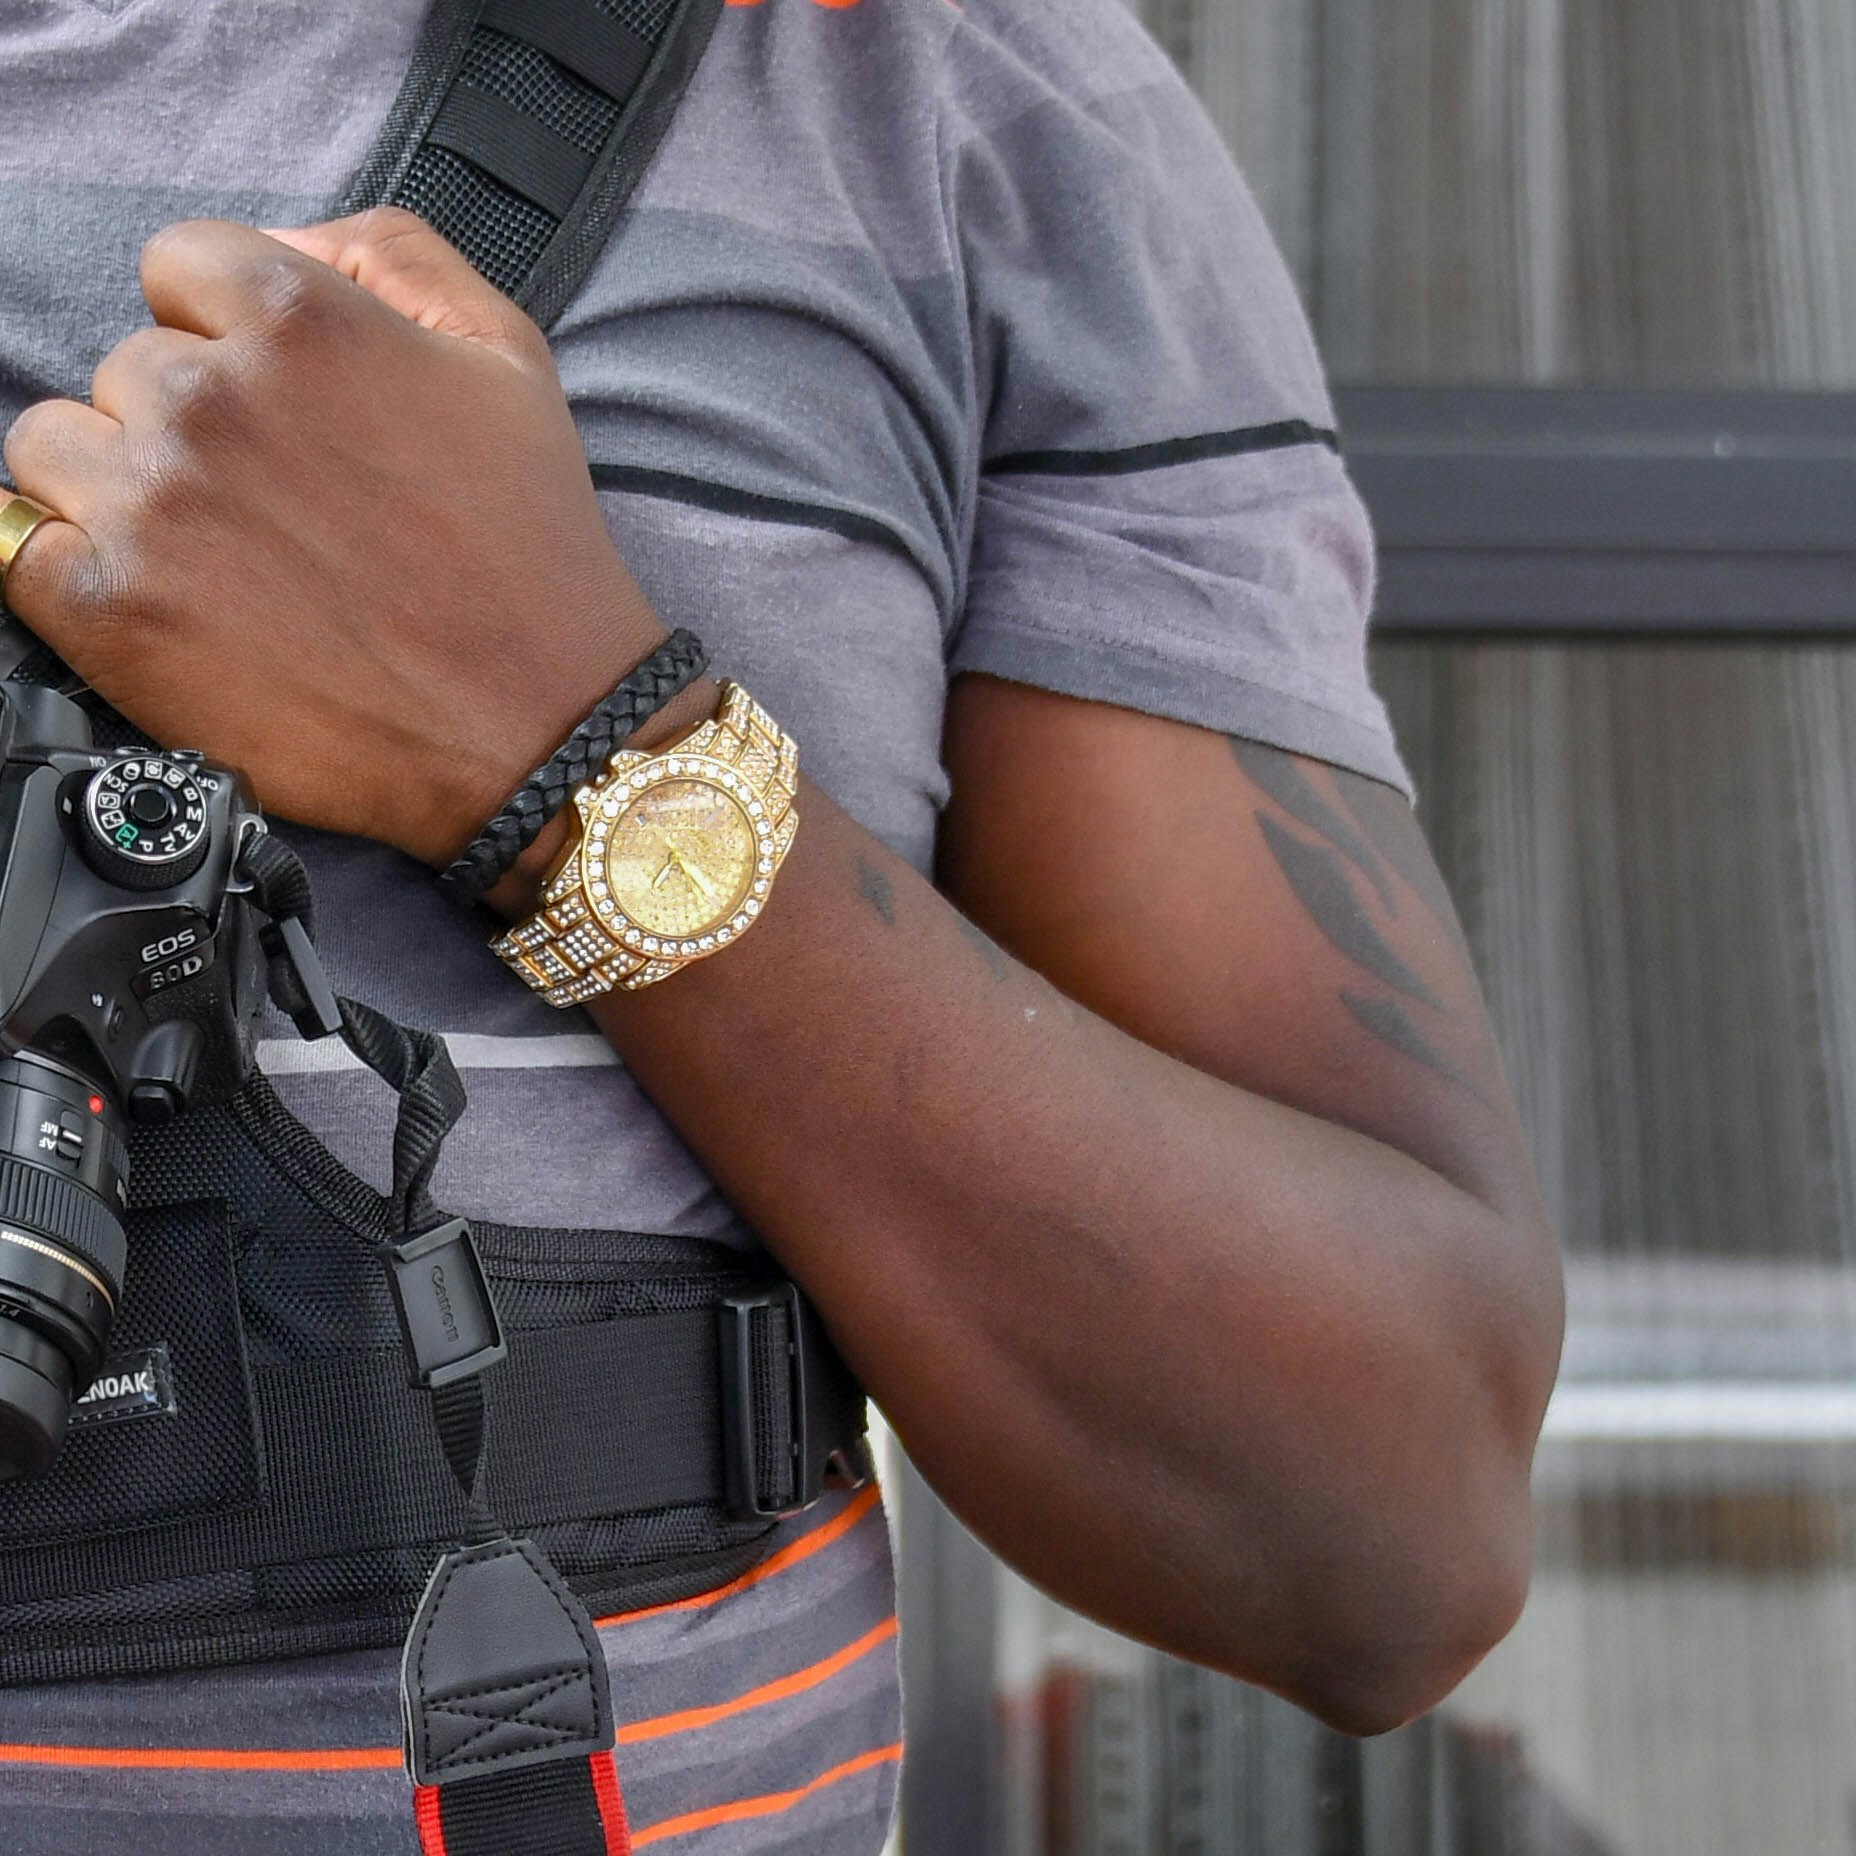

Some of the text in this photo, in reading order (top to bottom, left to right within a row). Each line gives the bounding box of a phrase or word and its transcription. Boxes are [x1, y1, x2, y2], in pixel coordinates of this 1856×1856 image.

[103, 772, 129, 793] SCN
[186, 806, 203, 822] M
[138, 839, 154, 853] P
[141, 928, 196, 963] EOS
[149, 956, 203, 989] 80D
[431, 1264, 460, 1344] Canon
